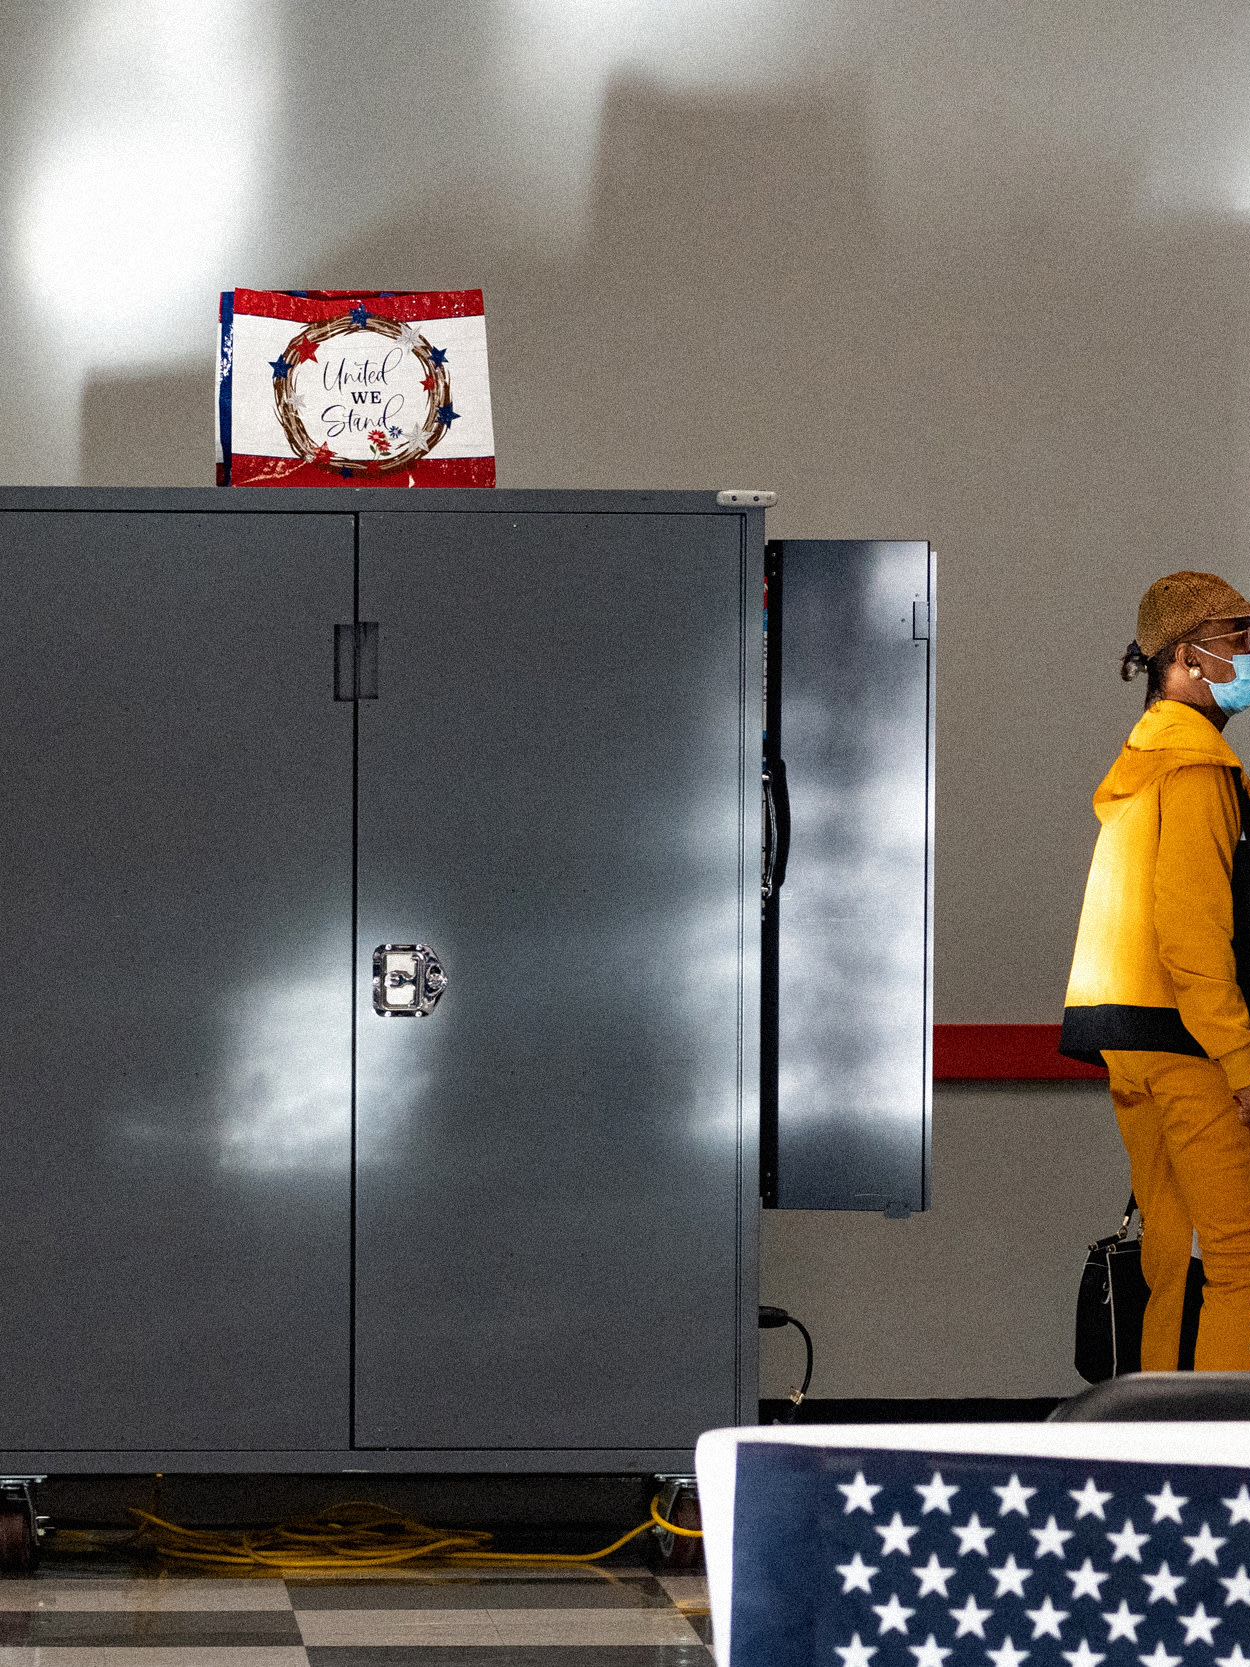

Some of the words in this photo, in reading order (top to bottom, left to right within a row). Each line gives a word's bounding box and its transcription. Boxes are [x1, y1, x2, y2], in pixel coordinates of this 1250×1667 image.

[323, 347, 404, 395] United
[321, 393, 405, 438] Stand
[351, 390, 382, 405] WE
